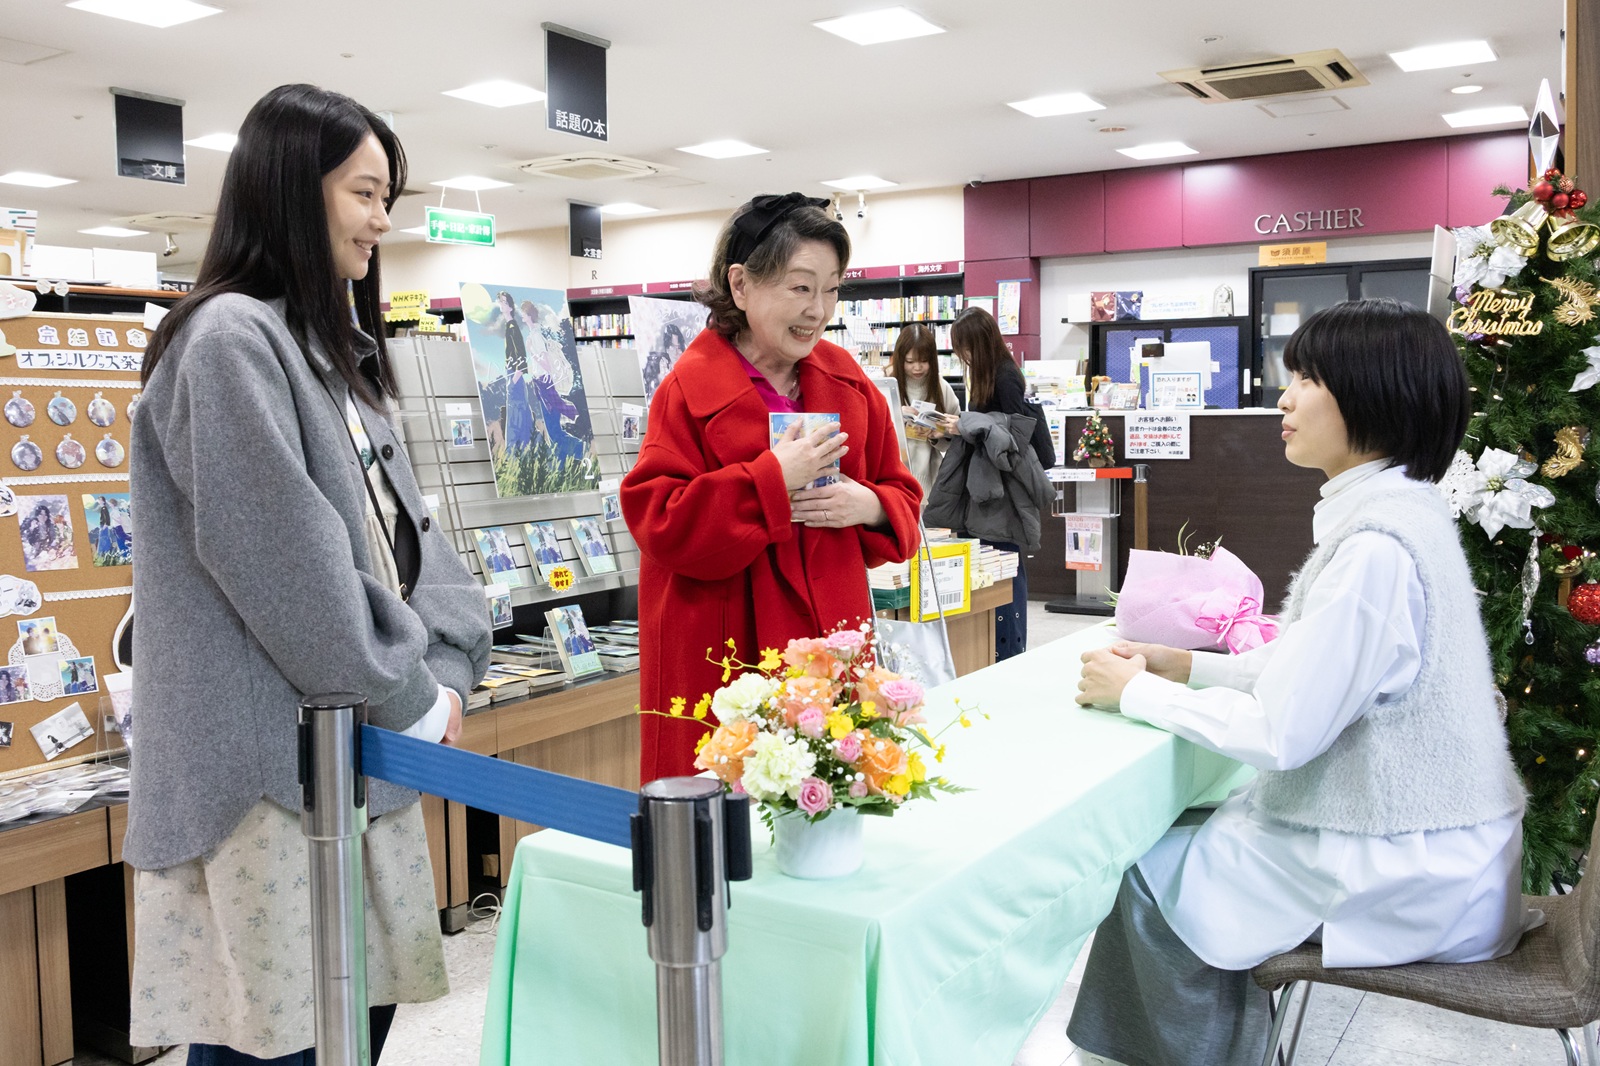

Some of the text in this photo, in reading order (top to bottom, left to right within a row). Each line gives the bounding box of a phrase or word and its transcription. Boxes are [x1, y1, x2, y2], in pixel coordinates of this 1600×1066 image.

[555, 109, 606, 137] 話題の本
[151, 163, 178, 179] 文庫
[1254, 207, 1364, 235] CASHIER
[917, 264, 942, 273] 海外文学
[1467, 288, 1536, 319] Merry
[1446, 306, 1544, 336] Christmas
[39, 326, 146, 345] 完結記念
